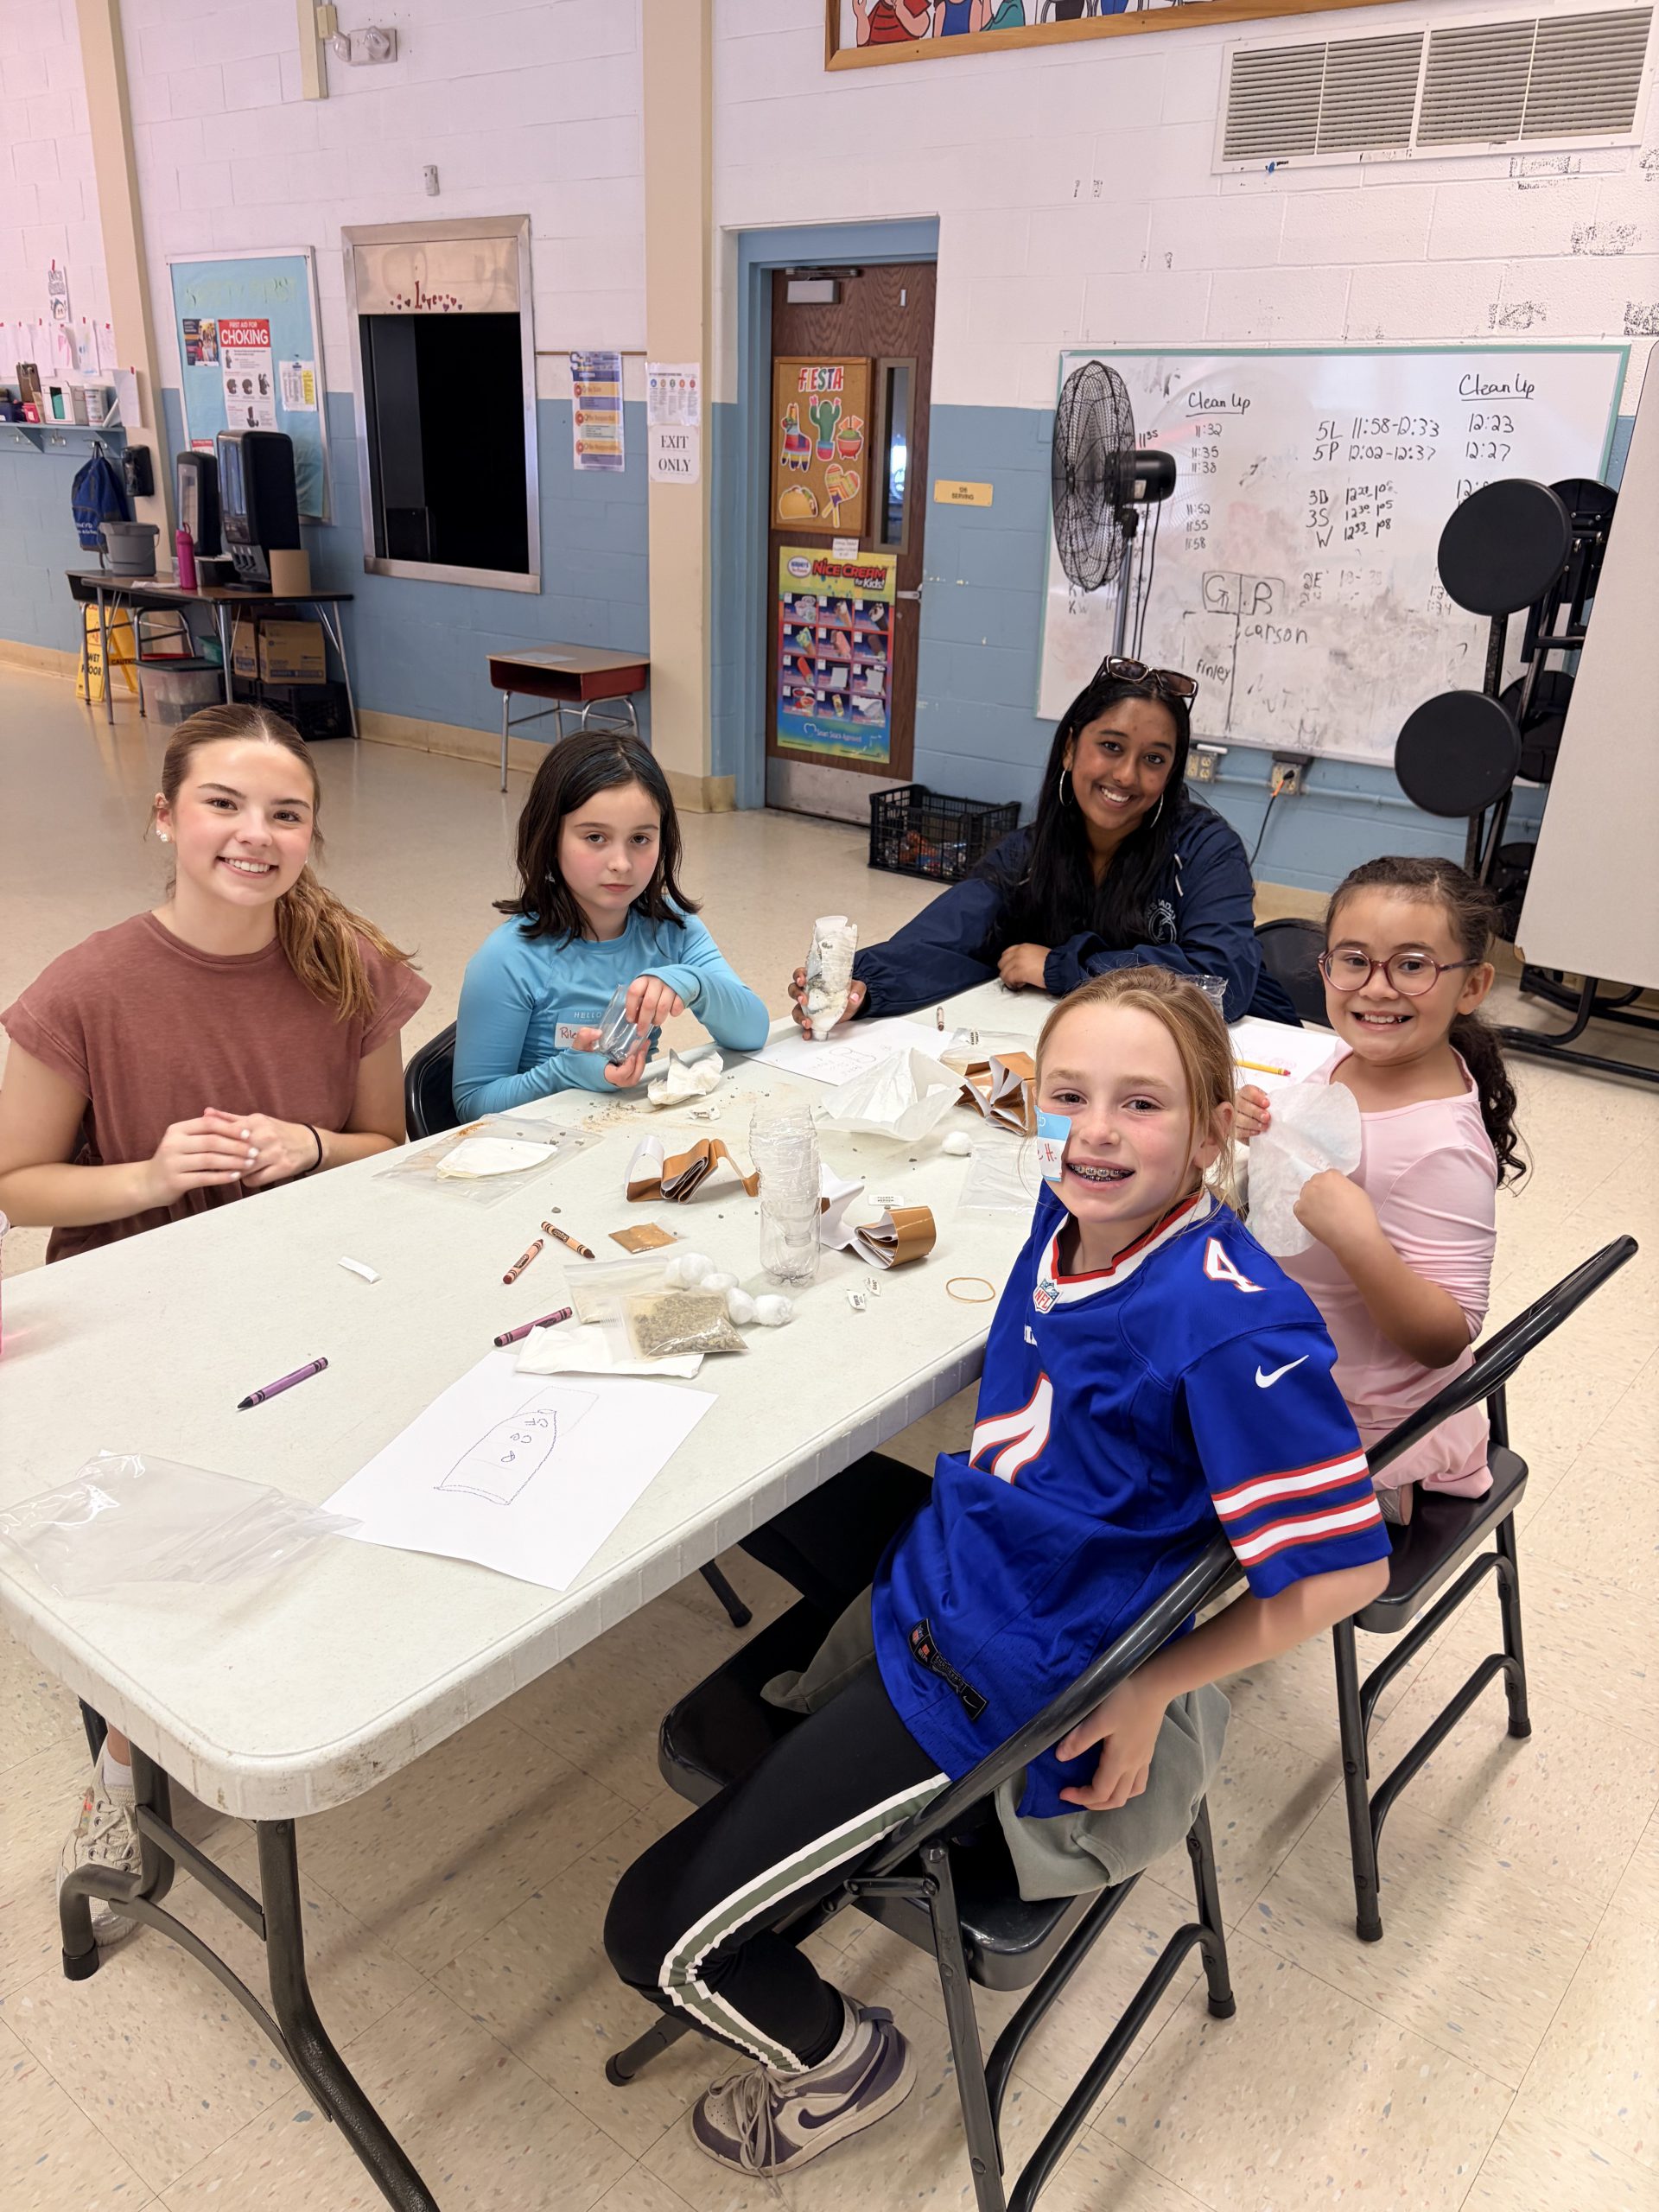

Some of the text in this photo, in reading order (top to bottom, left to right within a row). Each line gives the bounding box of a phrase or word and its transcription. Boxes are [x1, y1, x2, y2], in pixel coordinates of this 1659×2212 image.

[221, 329, 269, 345] CHOKING
[798, 366, 843, 391] FIESTA
[1459, 372, 1535, 398] Clean Up
[1188, 391, 1250, 415] Clean Up
[1468, 412, 1514, 433] 12:23
[661, 435, 689, 448] EXIT
[1313, 441, 1338, 461] 5P
[1465, 441, 1511, 461] 12:27
[658, 458, 690, 472] ONLY
[842, 563, 887, 579] CREAM
[87, 652, 100, 663] WET
[81, 664, 101, 676] FOOR
[1203, 1236, 1267, 1293] 4
[1034, 1289, 1051, 1309] NFL
